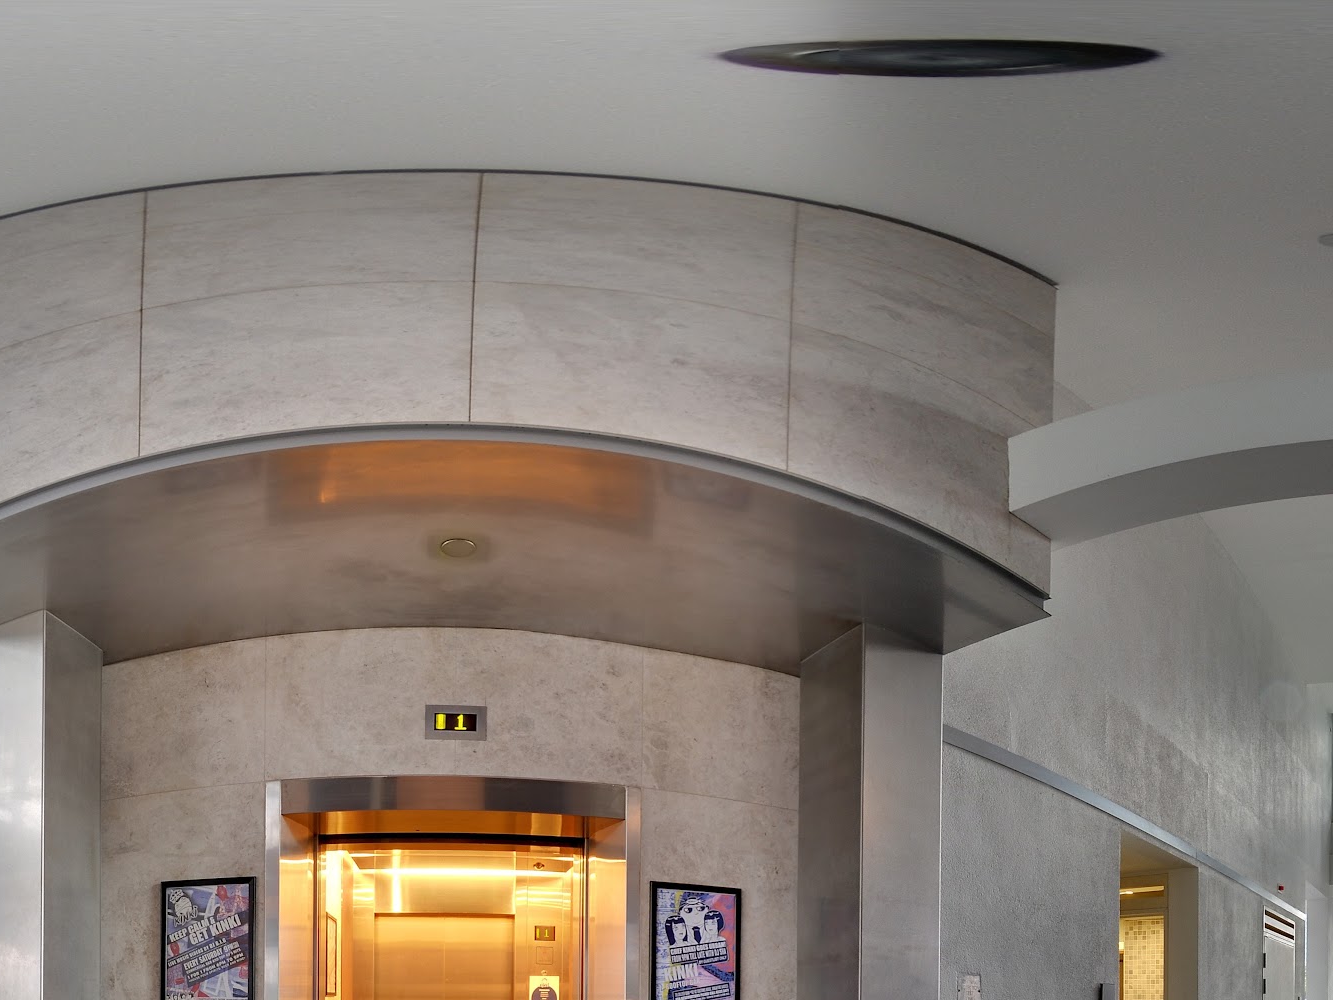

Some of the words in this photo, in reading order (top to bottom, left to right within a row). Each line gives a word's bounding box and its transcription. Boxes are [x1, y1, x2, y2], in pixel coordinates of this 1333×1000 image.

[454, 714, 467, 730] 1
[169, 928, 187, 943] KEEP
[188, 918, 210, 934] CALM
[210, 916, 216, 926] &
[189, 929, 210, 945] GET
[210, 914, 242, 937] KINKI
[183, 957, 199, 970] EVERY
[199, 948, 223, 964] SATURDAY
[664, 962, 698, 981] KINKI
